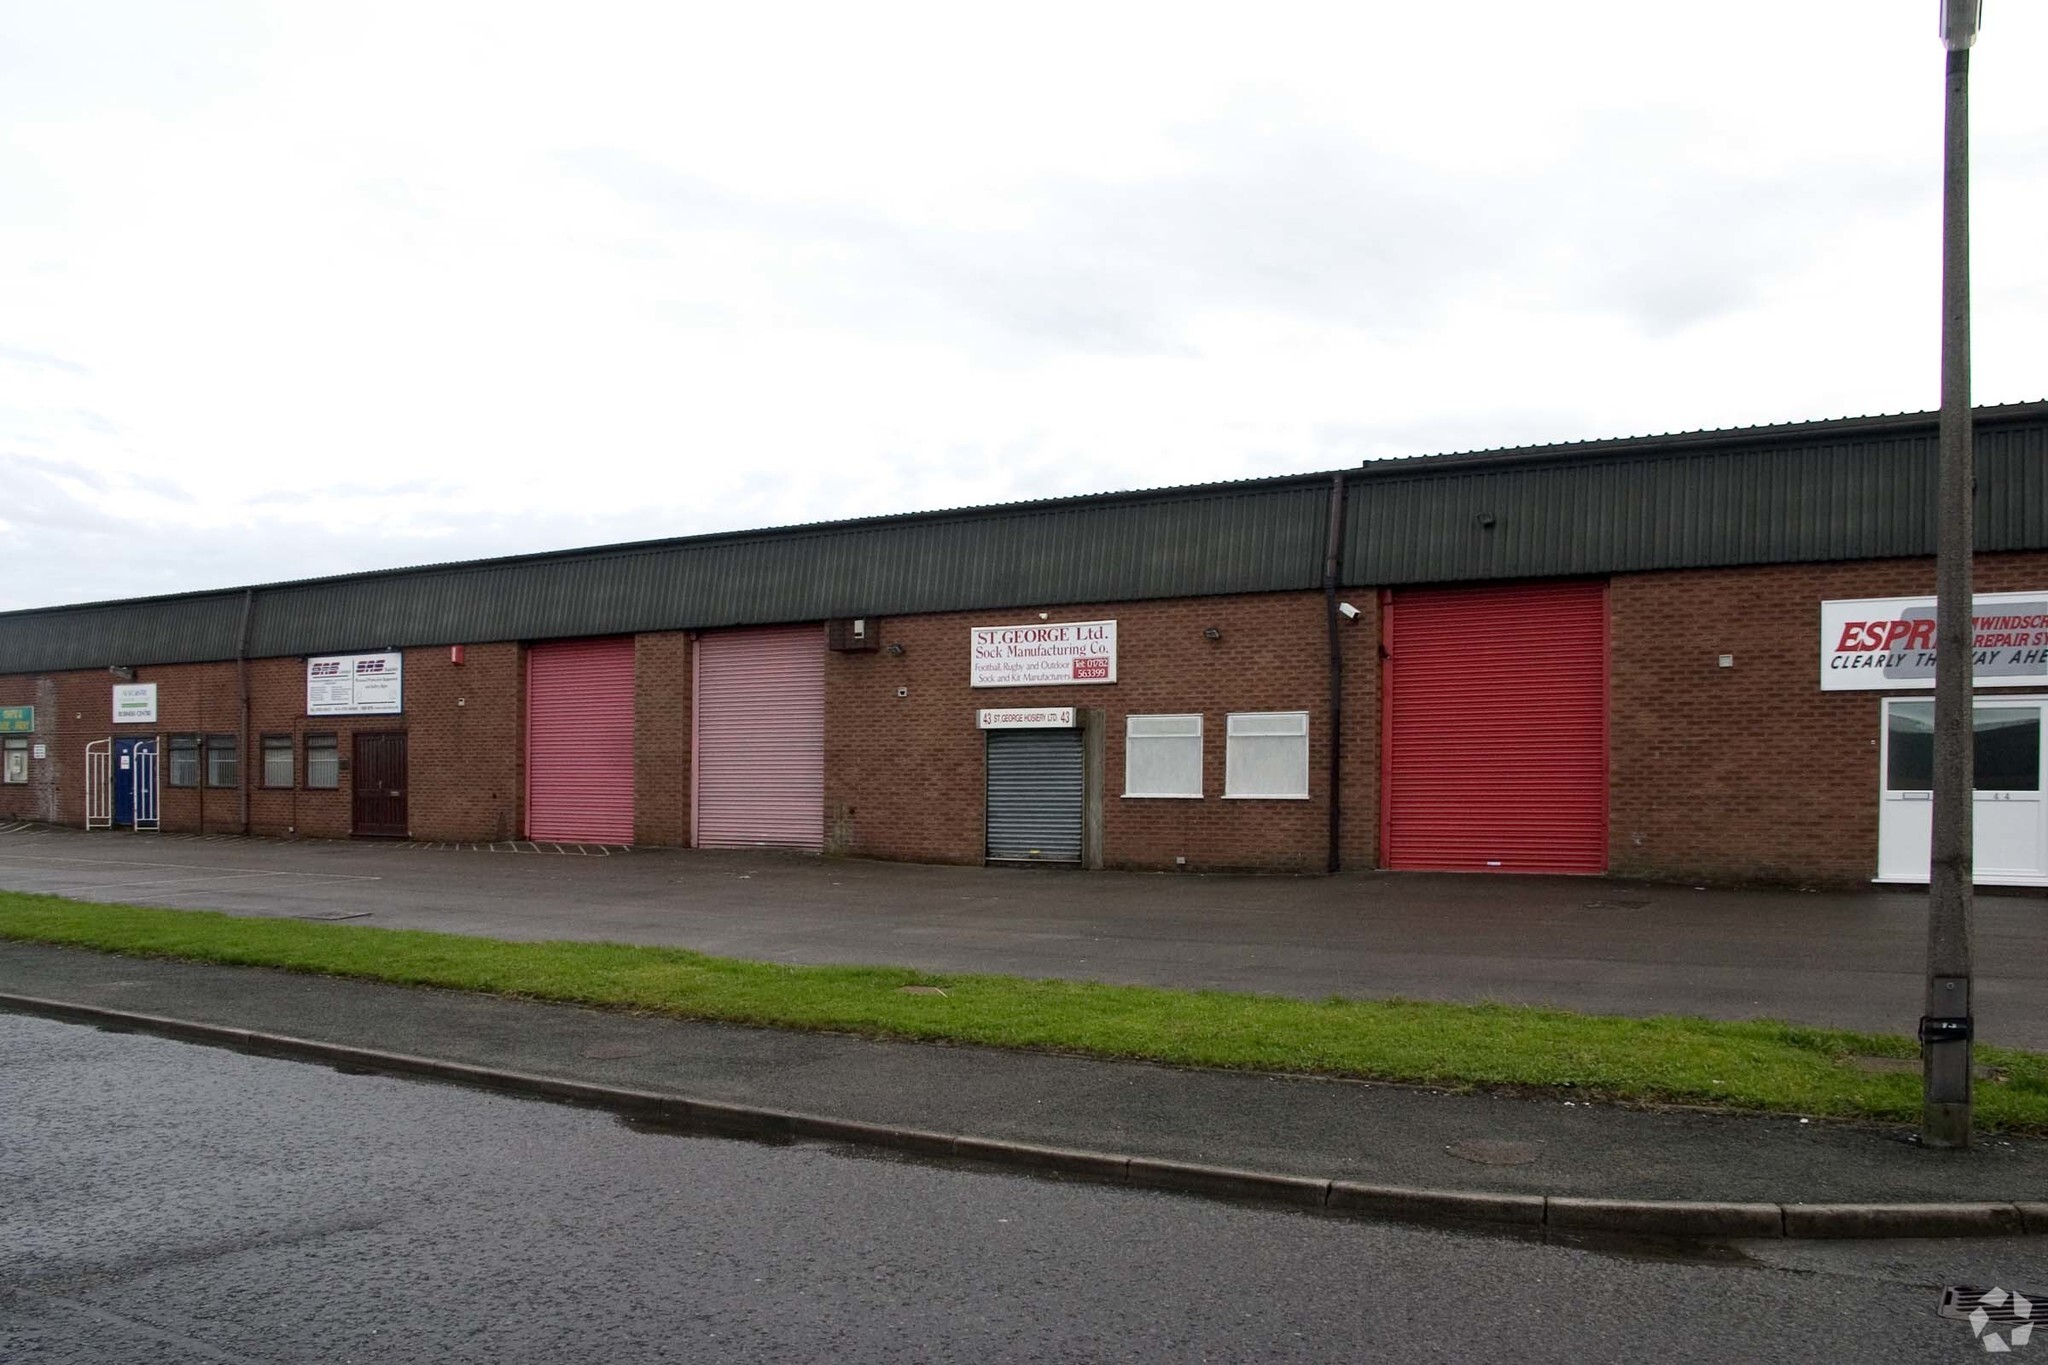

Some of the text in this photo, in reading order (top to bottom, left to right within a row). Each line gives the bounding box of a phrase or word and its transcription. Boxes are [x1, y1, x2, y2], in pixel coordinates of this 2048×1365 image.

[1076, 626, 1109, 641] Ltd.
[1835, 618, 1979, 653] ESPR
[1973, 633, 2029, 648] REPAIR
[975, 641, 1109, 659] Sock Manufacturing Co.
[1003, 662, 1023, 672] Rugby
[1026, 661, 1039, 670] and
[1040, 660, 1070, 670] Outdoor
[1086, 659, 1108, 667] 01782
[1830, 653, 1908, 669] CLEARLY
[1915, 652, 1937, 667] TH
[2008, 650, 2048, 664] AHE
[978, 673, 997, 683] Sock
[997, 673, 1010, 682] and
[1023, 672, 1070, 682] Manufacturers
[1077, 669, 1106, 678] 563399
[983, 712, 991, 724] 43
[1024, 714, 1046, 722] HOSIERY
[1060, 711, 1070, 723] 43
